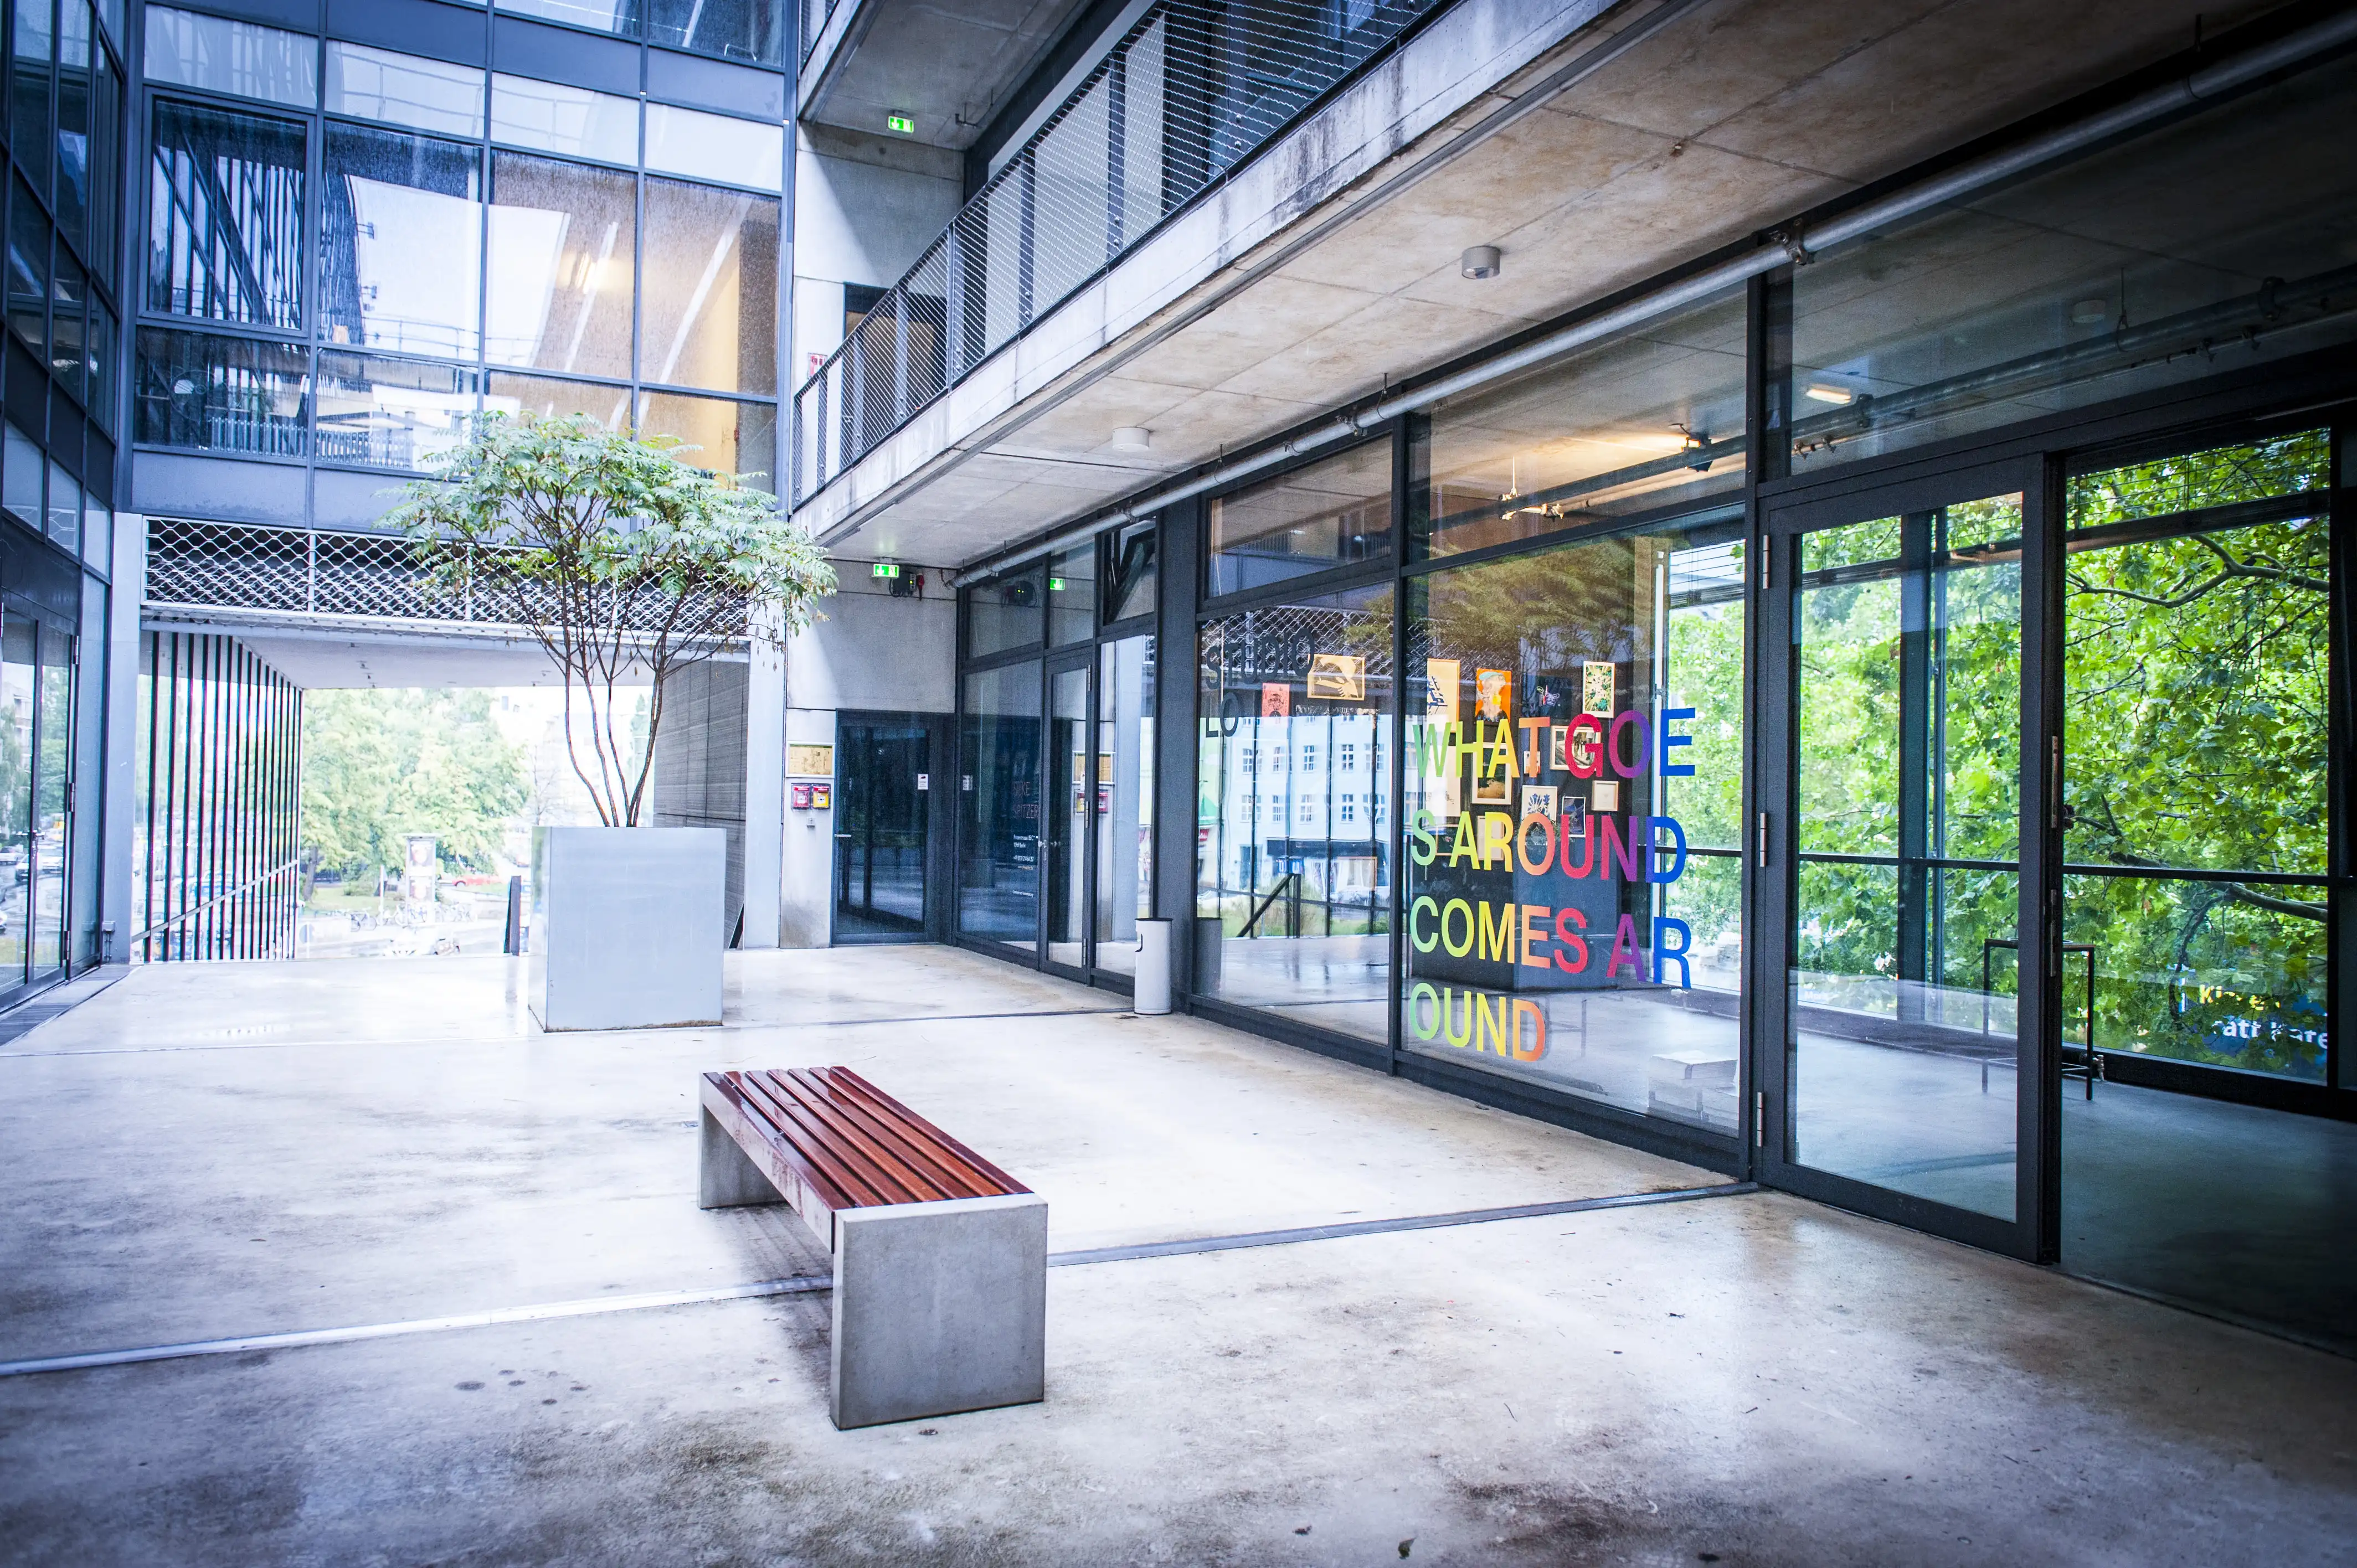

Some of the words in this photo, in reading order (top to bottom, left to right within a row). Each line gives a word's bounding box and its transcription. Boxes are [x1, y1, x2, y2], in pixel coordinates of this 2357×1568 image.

[1206, 628, 1315, 690] STUDIO
[1206, 692, 1240, 737] LO
[1412, 716, 1550, 778] WHAT
[1565, 707, 1696, 780] GOE
[1411, 809, 1437, 866] S
[1449, 812, 1687, 884] AROUND
[1410, 895, 1588, 974] COMES
[1606, 914, 1691, 989] AR
[1409, 983, 1546, 1062] OUND
